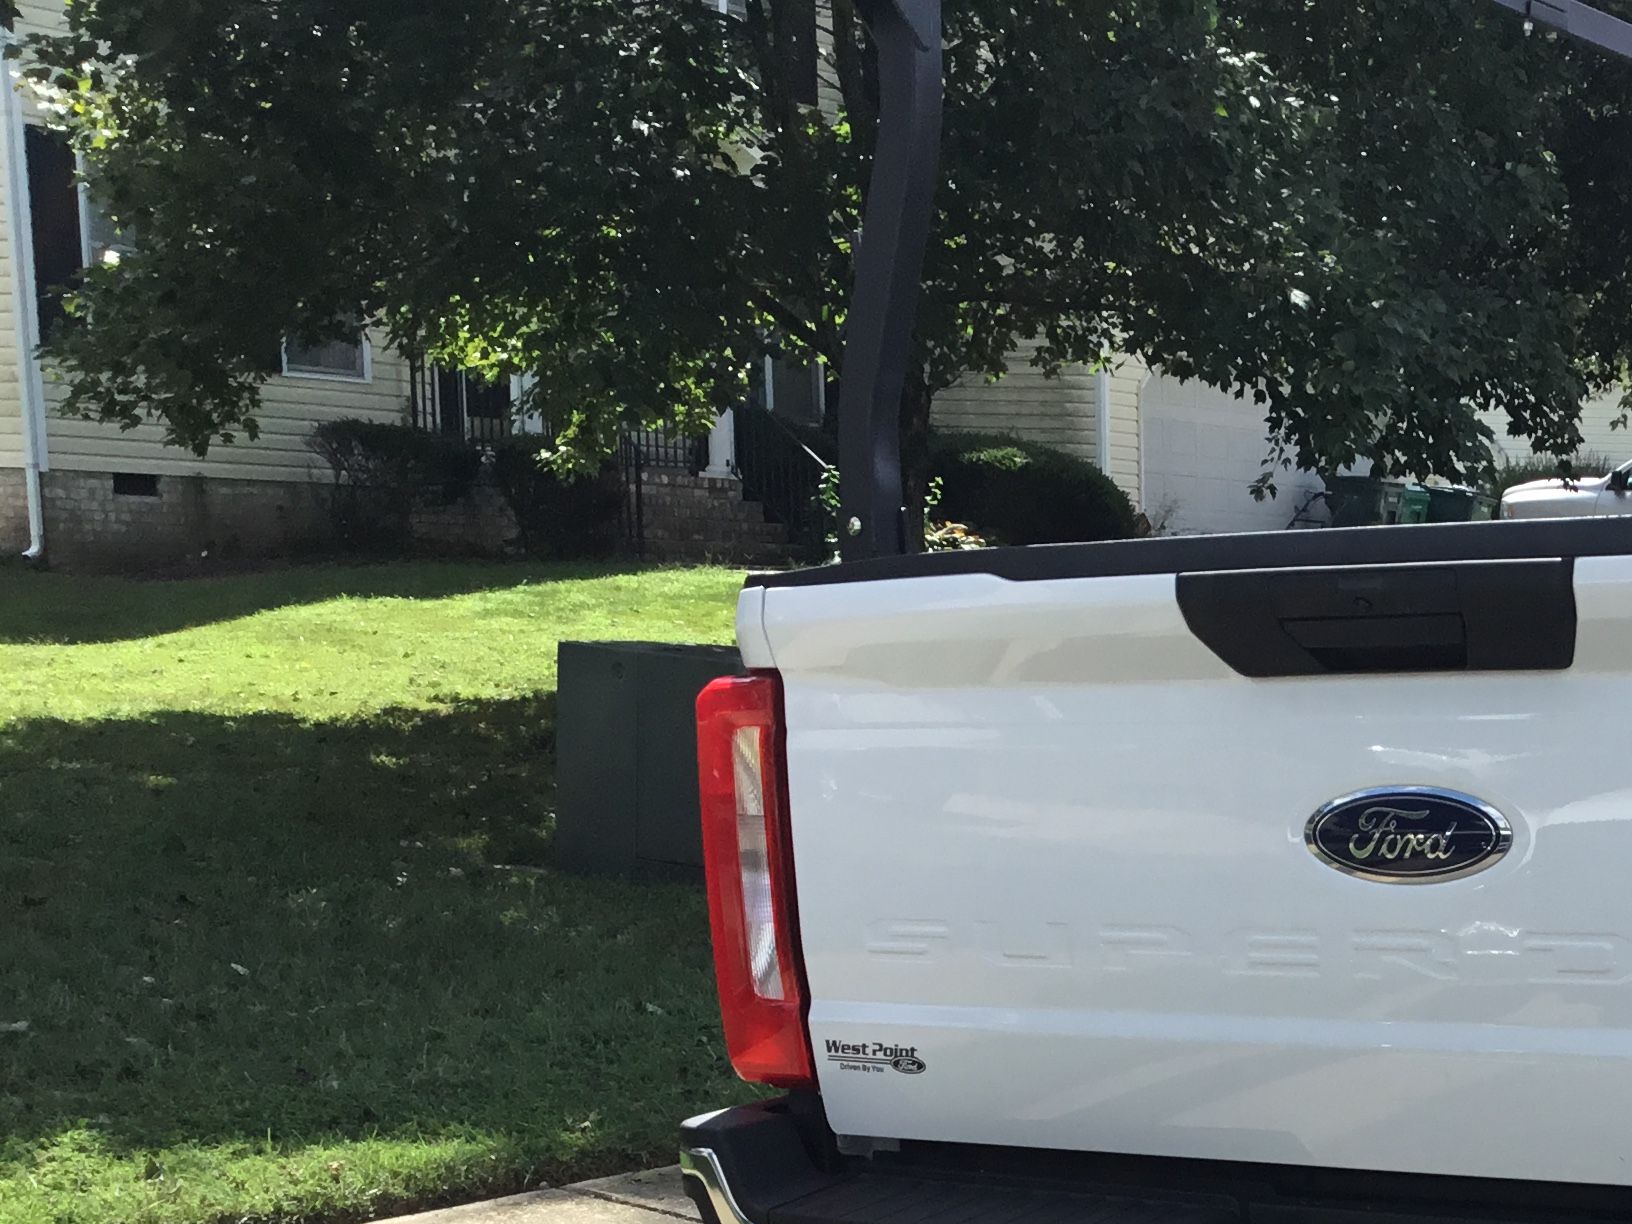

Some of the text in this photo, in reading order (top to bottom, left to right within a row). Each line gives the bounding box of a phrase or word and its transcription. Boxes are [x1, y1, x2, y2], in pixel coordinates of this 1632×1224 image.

[1348, 805, 1458, 861] Ford
[866, 918, 1460, 980] SUPER
[825, 1039, 917, 1058] West Point
[840, 1062, 884, 1073] Driven By You
[897, 1058, 919, 1072] Ford
